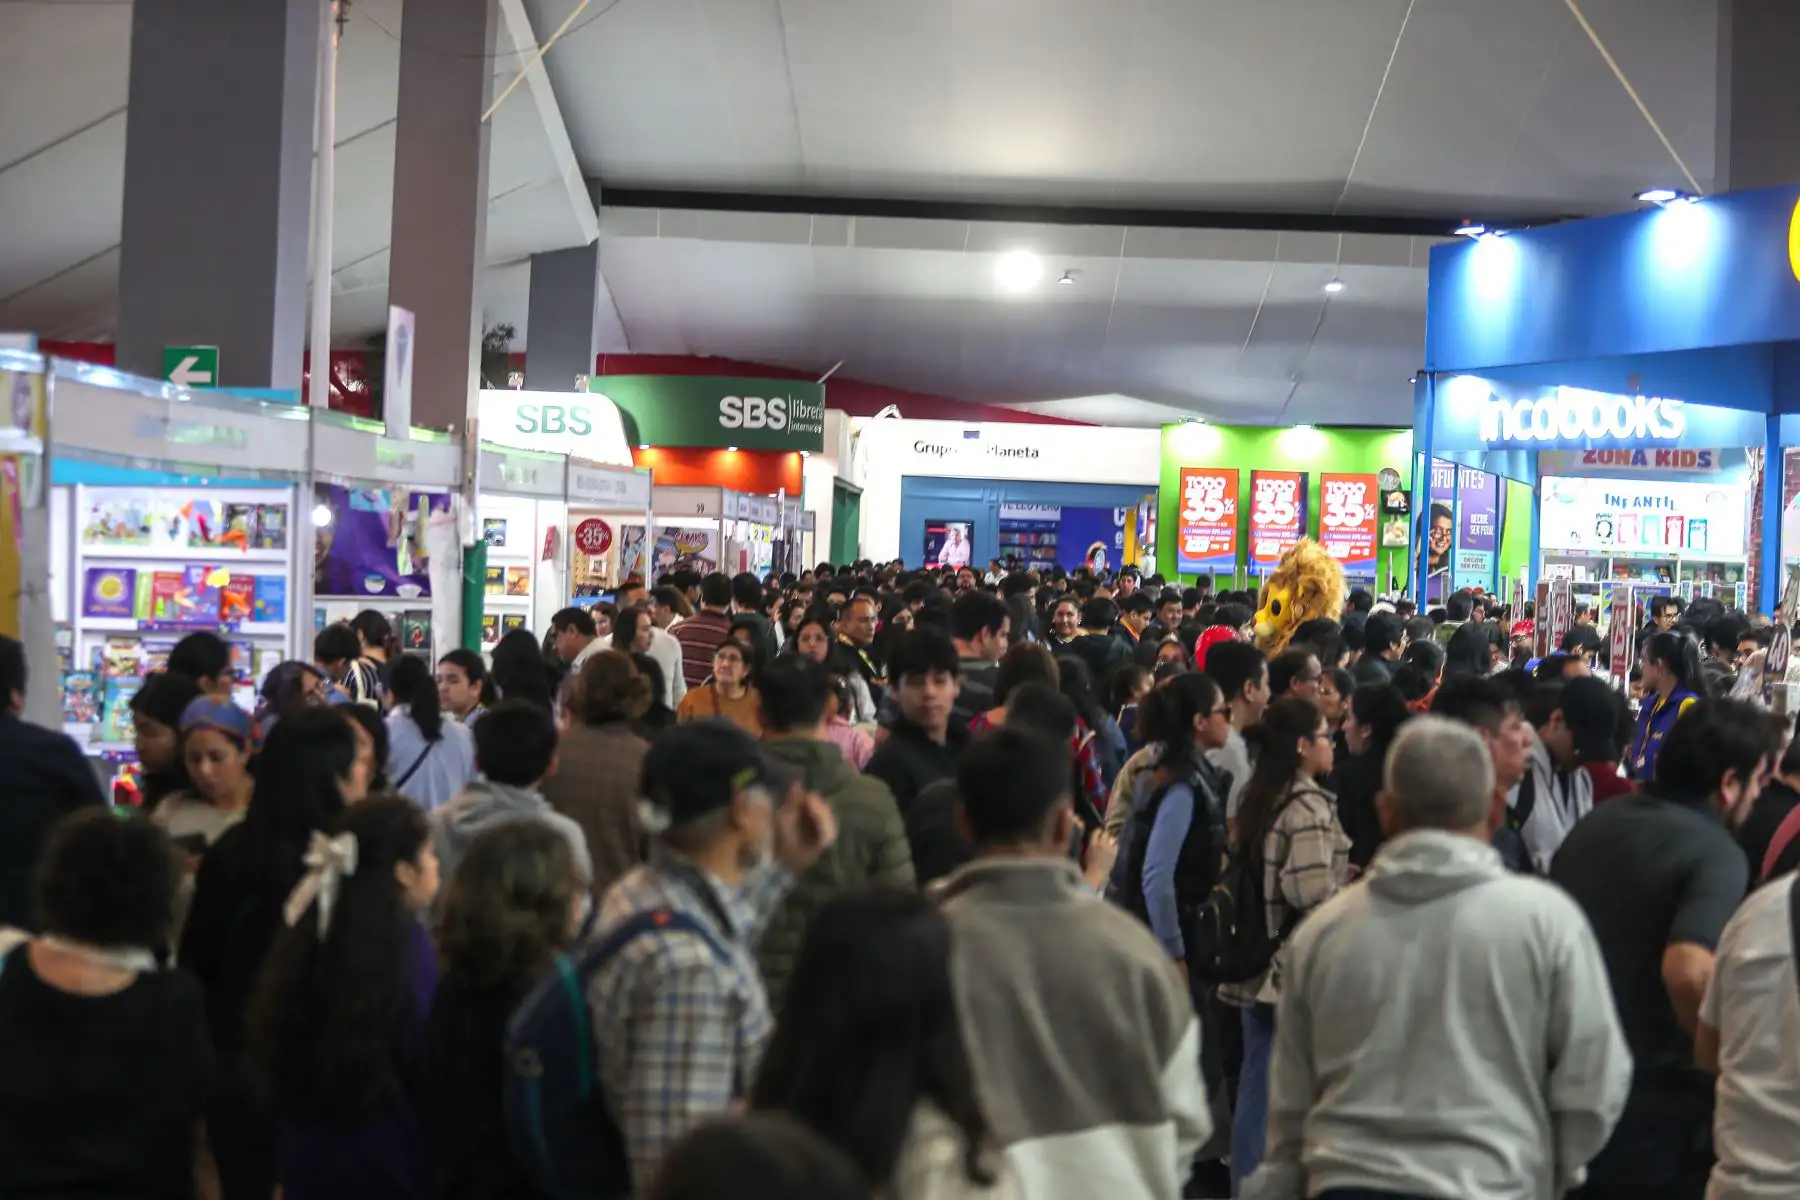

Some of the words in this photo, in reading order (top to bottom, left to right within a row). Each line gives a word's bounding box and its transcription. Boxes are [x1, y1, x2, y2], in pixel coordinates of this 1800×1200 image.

[515, 404, 593, 436] SBS
[719, 395, 787, 430] SBS
[913, 440, 957, 459] Grup
[987, 444, 1039, 459] laneta
[1655, 450, 1712, 468] KIDS
[1185, 475, 1227, 489] TODO
[1256, 478, 1297, 492] TODO
[1325, 481, 1367, 494] TODO
